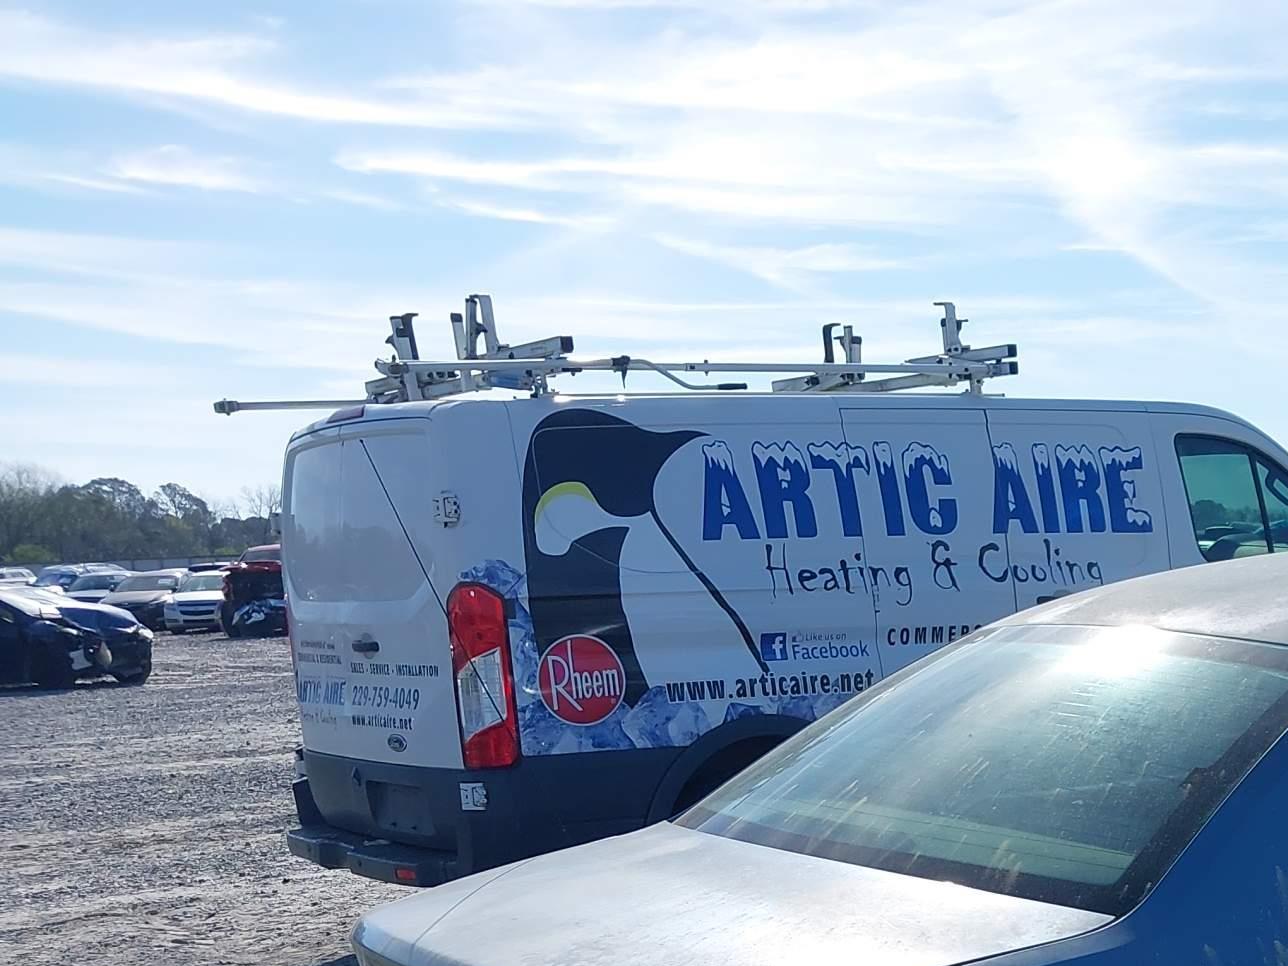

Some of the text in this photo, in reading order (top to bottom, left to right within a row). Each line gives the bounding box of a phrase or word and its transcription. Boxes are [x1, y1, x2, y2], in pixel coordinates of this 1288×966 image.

[701, 440, 1153, 541] ARTIC AIRE
[765, 538, 1104, 605] Heating & Cooling
[805, 632, 823, 641] Like
[824, 633, 834, 641] us
[792, 640, 870, 660] Facebook
[395, 664, 439, 677] INSTALLATION
[547, 640, 620, 711] Rheem
[352, 685, 420, 710] 229-759-4049
[666, 668, 874, 703] www.articaire.net
[352, 714, 413, 730] www.articaire.net
